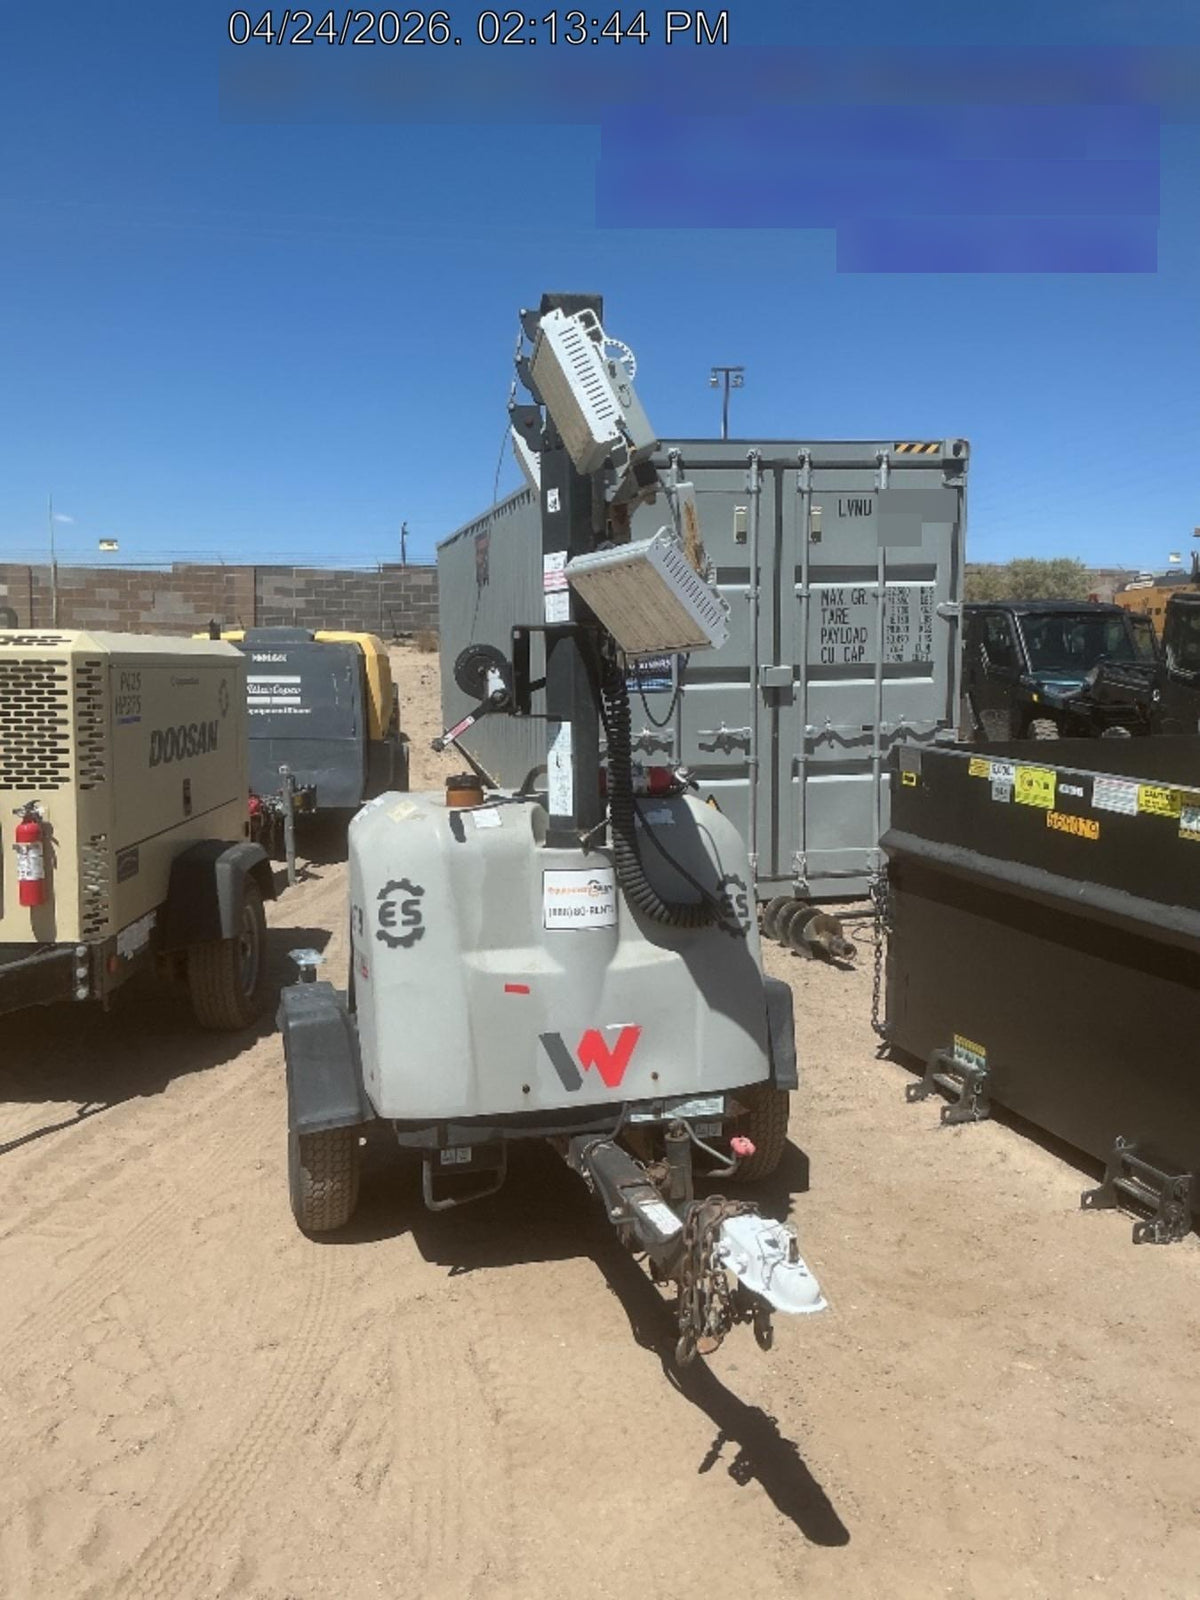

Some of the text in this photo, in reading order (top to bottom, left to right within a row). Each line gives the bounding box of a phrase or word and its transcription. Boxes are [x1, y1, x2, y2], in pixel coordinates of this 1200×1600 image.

[821, 607, 850, 625] TARE
[821, 627, 869, 645] PAYLOAD
[148, 719, 219, 768] DOOSAN
